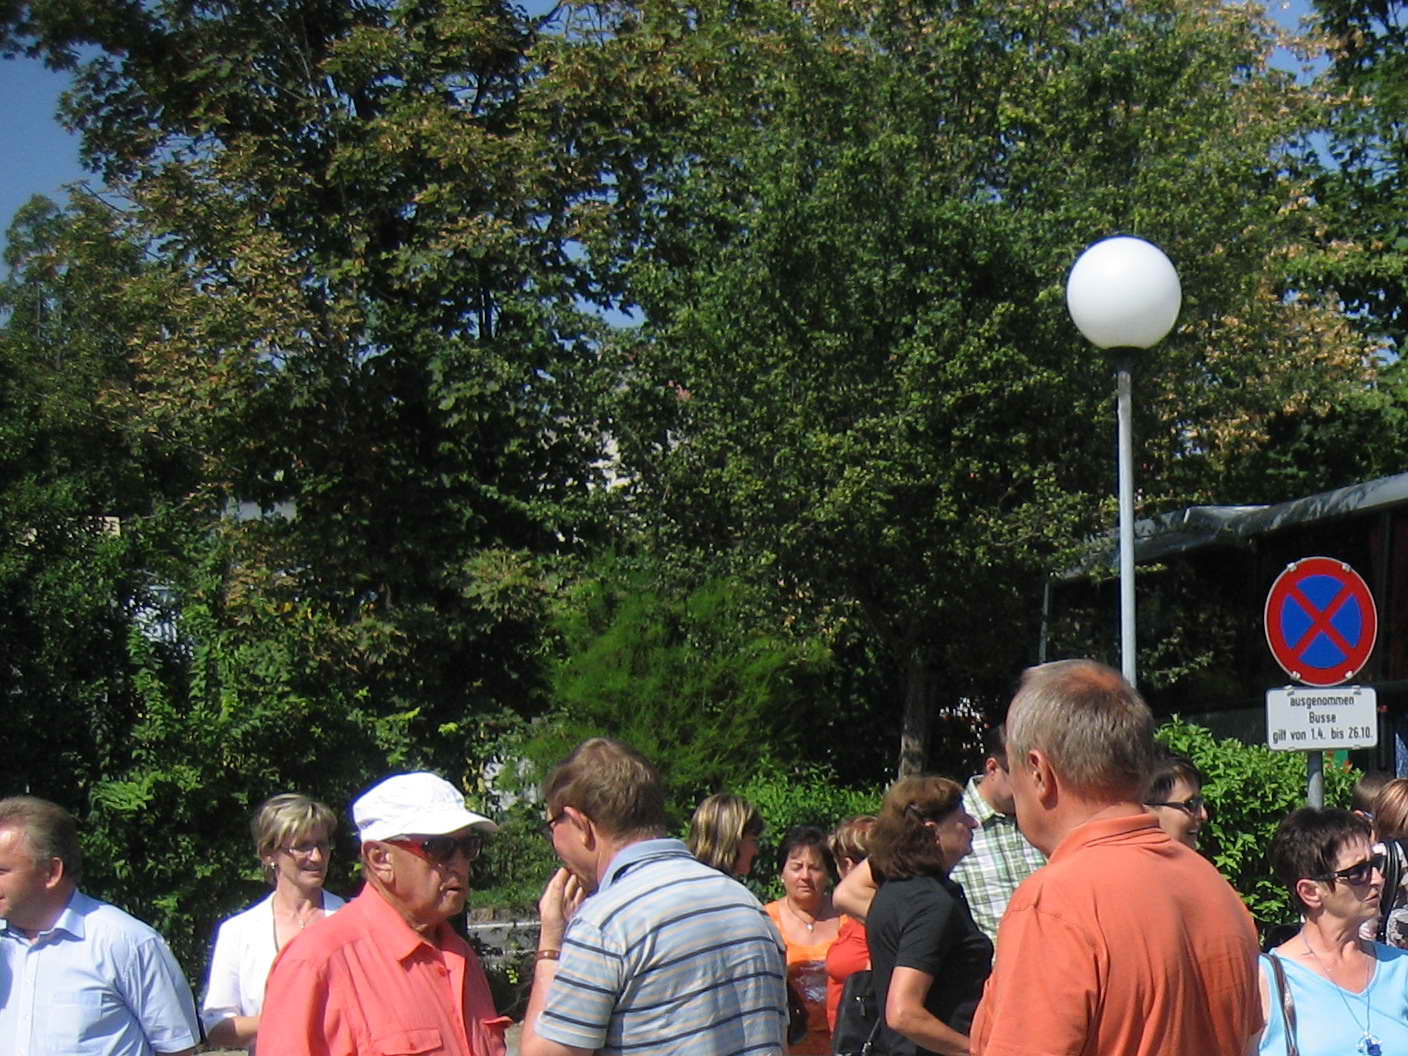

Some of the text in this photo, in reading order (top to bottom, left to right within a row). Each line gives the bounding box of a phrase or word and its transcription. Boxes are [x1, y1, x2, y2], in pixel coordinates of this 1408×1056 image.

[1290, 696, 1354, 709] ausgenommen
[1308, 711, 1336, 723] Busse
[1273, 726, 1373, 744] gilt von 1.4. bis 26.10.
